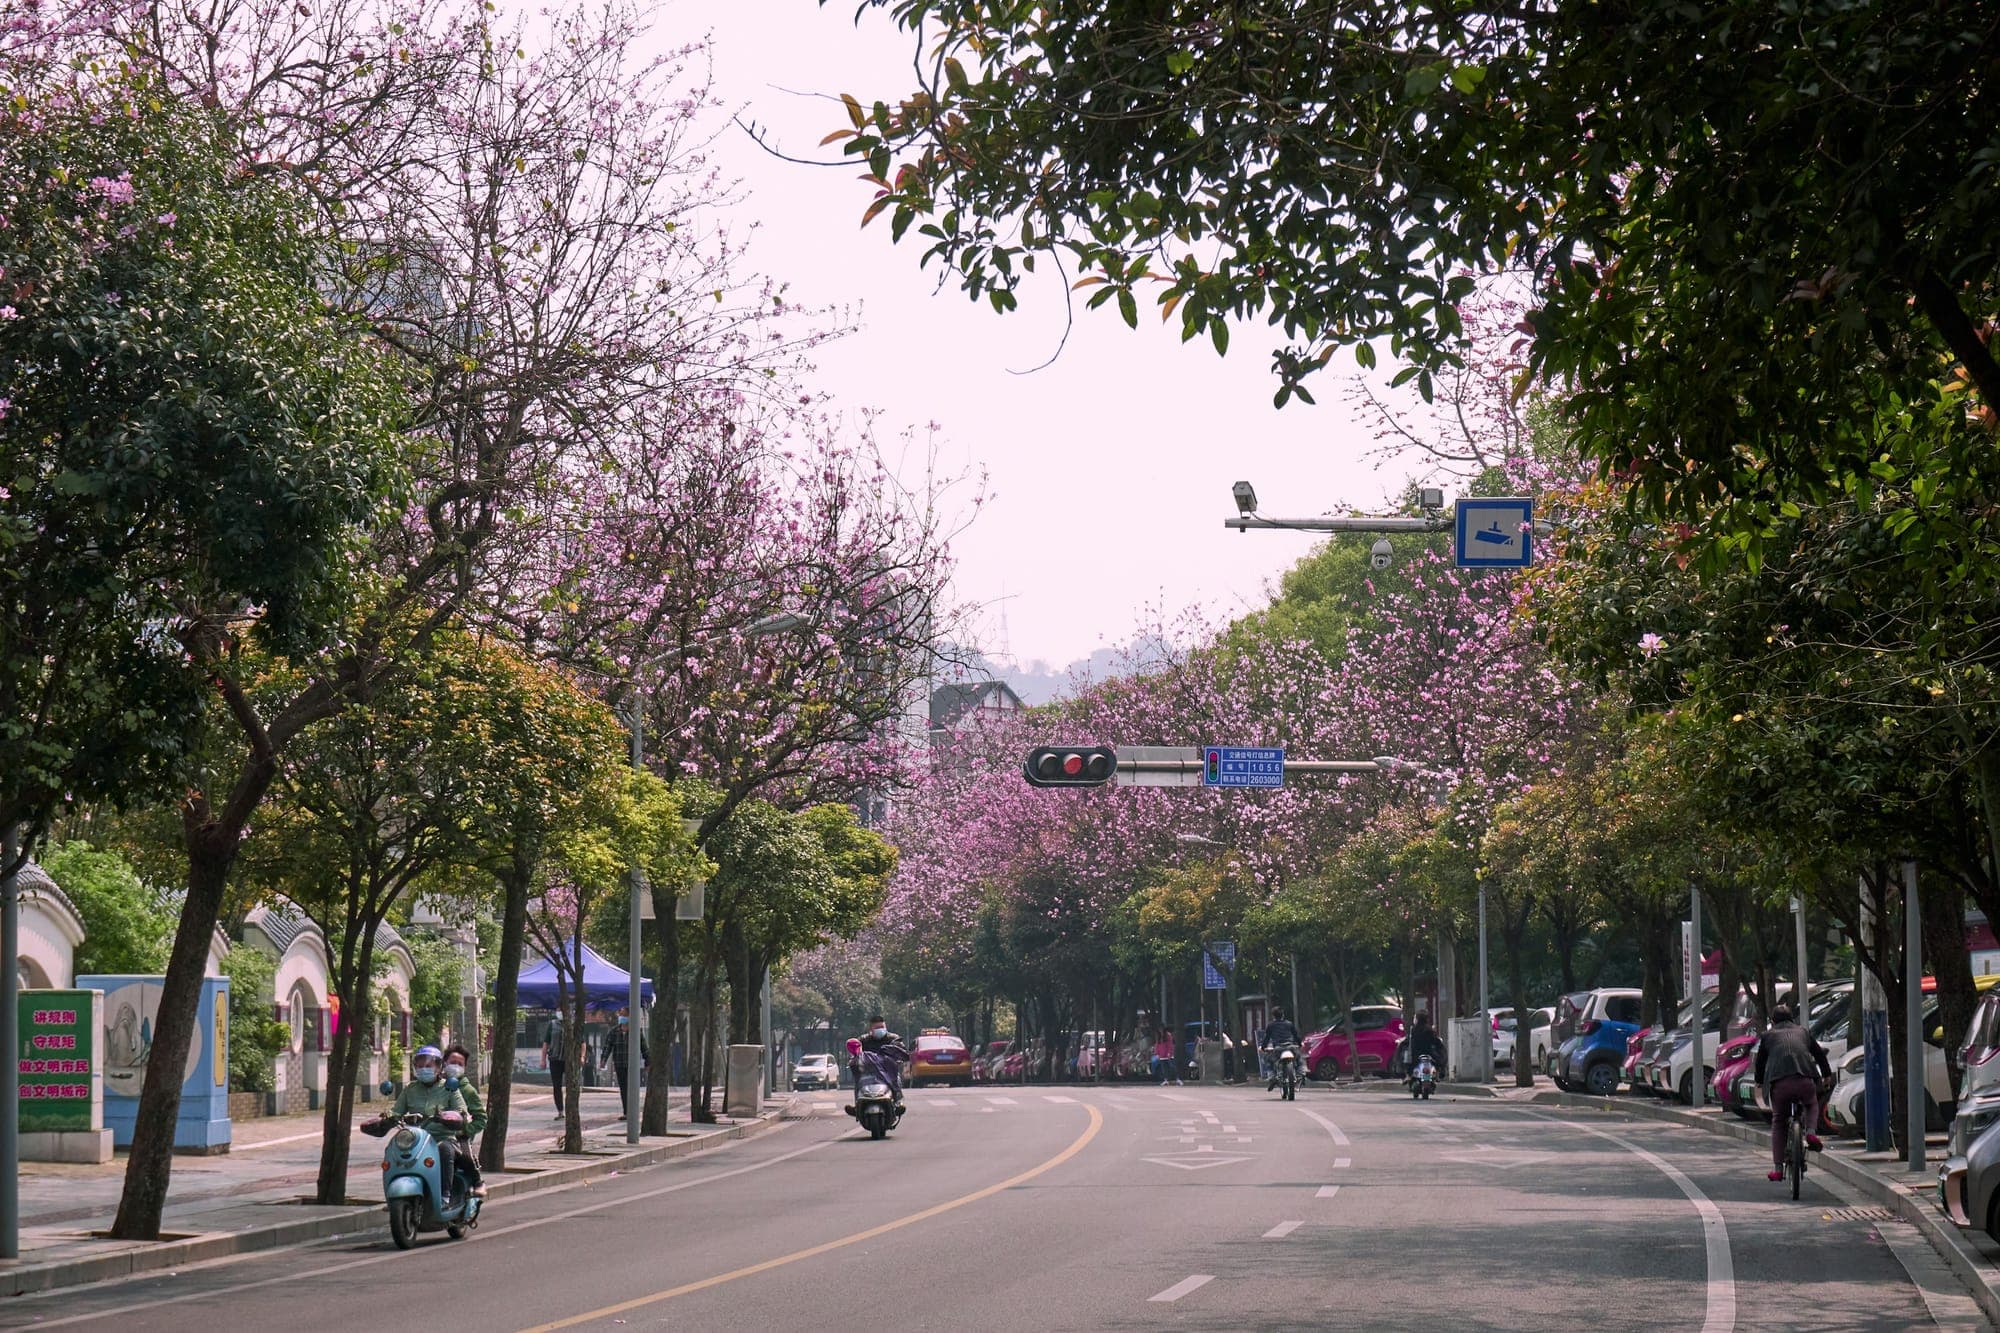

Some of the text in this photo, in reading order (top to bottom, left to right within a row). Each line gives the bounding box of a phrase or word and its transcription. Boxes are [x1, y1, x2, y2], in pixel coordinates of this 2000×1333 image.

[1250, 775, 1280, 784] 2603000
[33, 1010, 76, 1024] 讲规则
[32, 1034, 76, 1049] 守规矩
[18, 1059, 89, 1074] 做文明市民
[18, 1084, 89, 1099] 创文明城市
